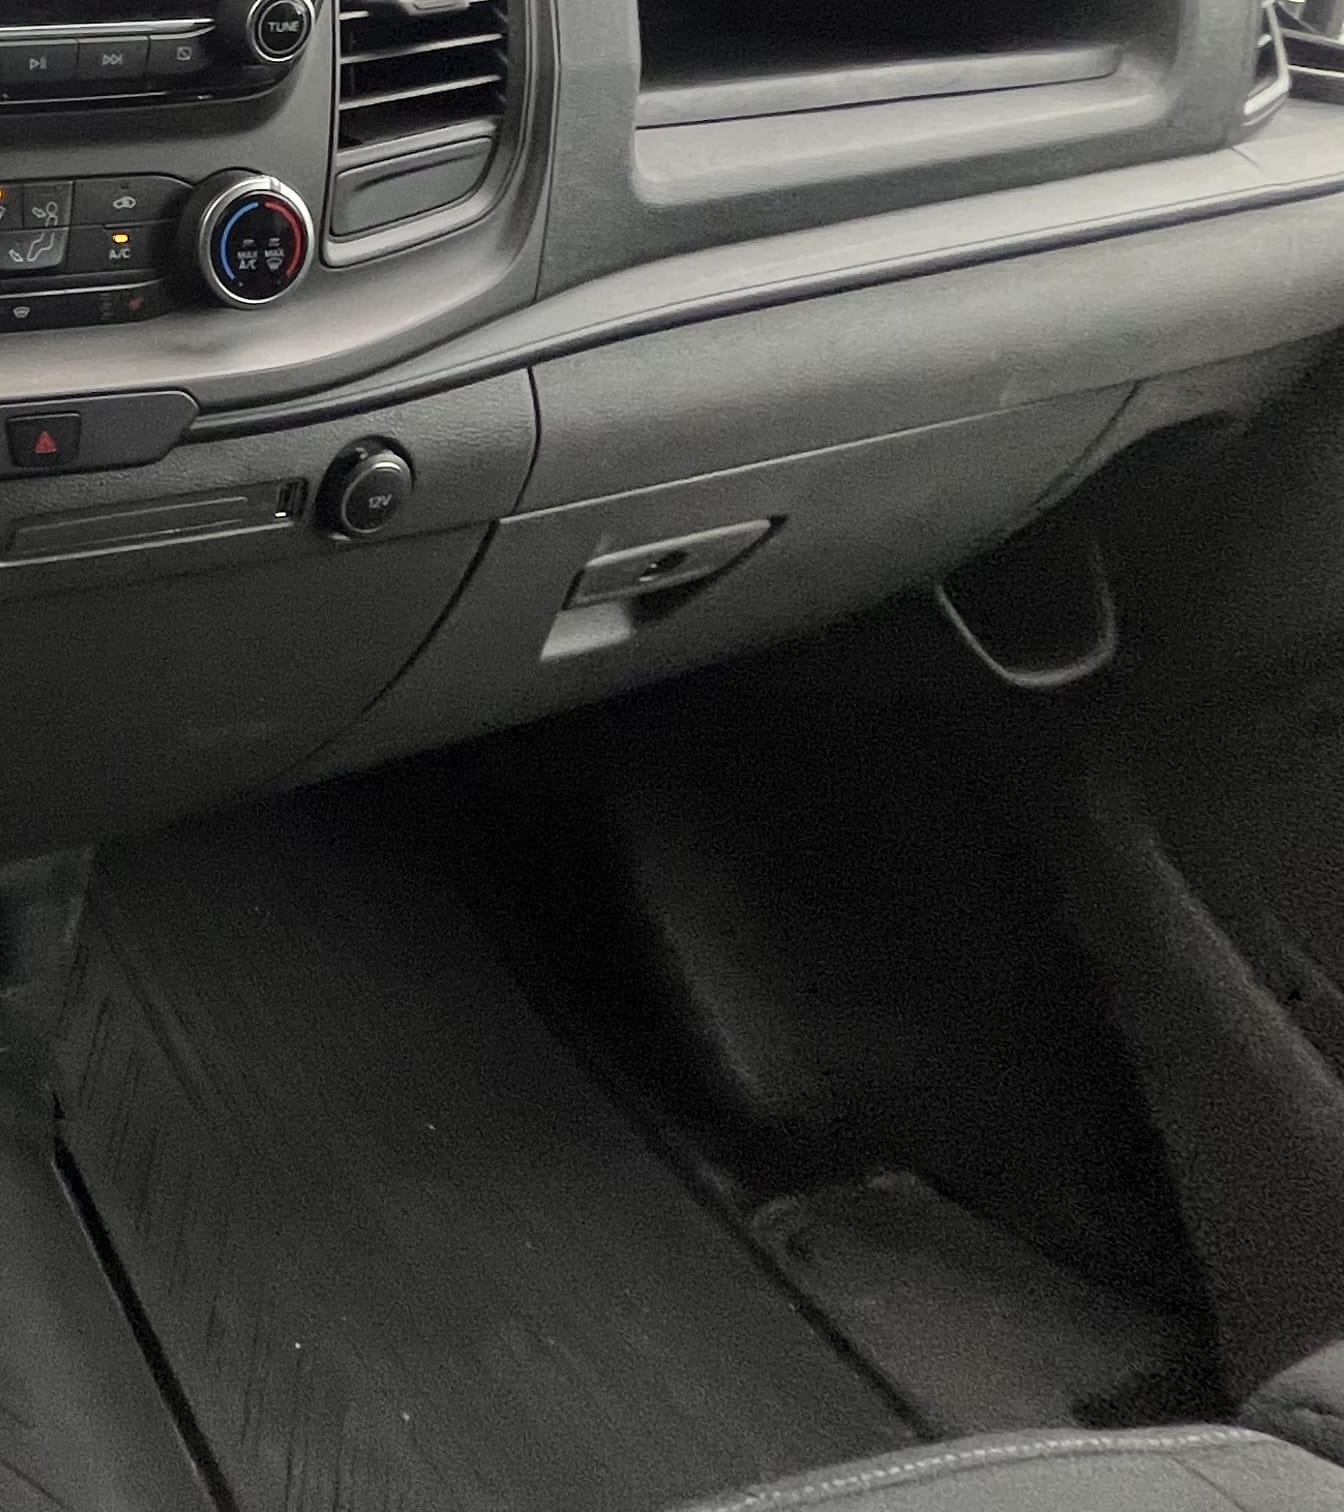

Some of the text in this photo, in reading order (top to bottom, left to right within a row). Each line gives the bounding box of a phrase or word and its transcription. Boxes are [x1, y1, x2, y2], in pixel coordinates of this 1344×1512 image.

[267, 19, 299, 34] TUNE
[109, 248, 131, 260] A/C
[368, 492, 392, 510] 12V
